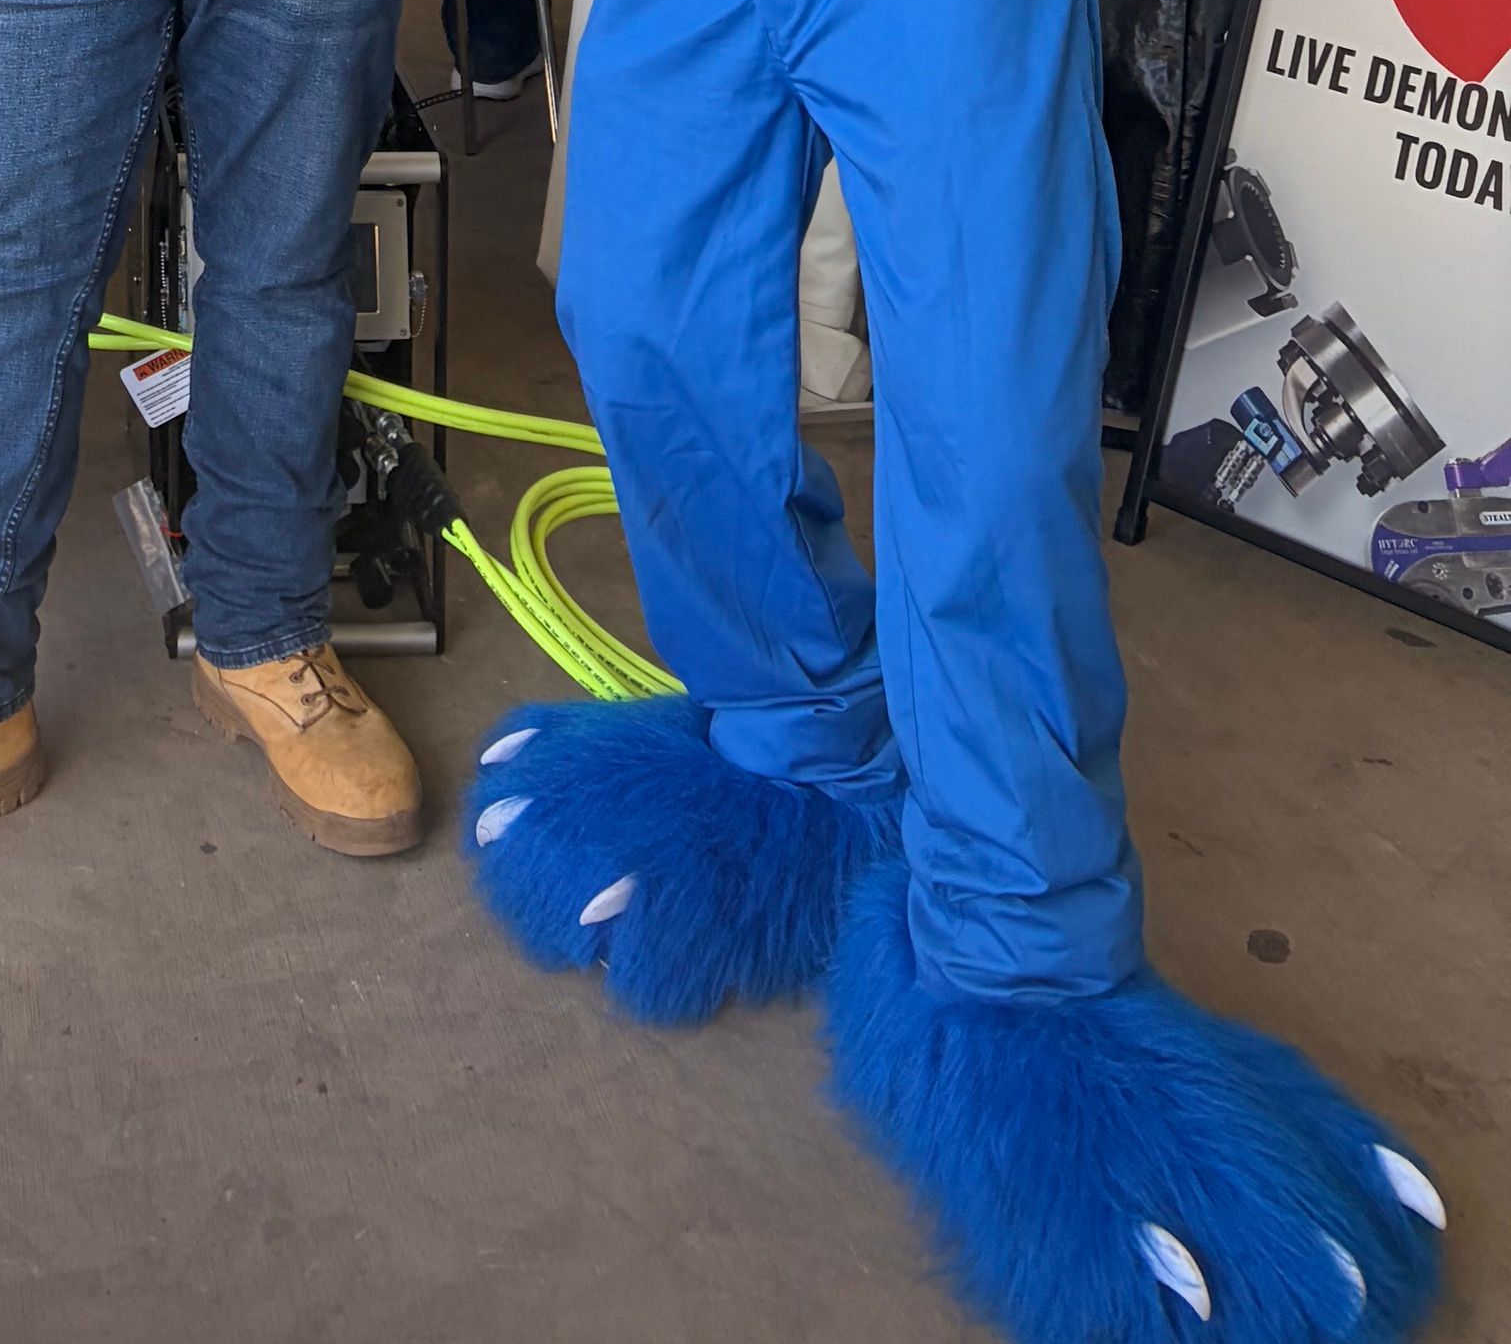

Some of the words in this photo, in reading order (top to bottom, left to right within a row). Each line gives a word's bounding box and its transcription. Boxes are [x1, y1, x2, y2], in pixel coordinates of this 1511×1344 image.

[1266, 28, 1357, 95] LIVE
[1394, 131, 1508, 212] TODA
[148, 347, 191, 373] WARN
